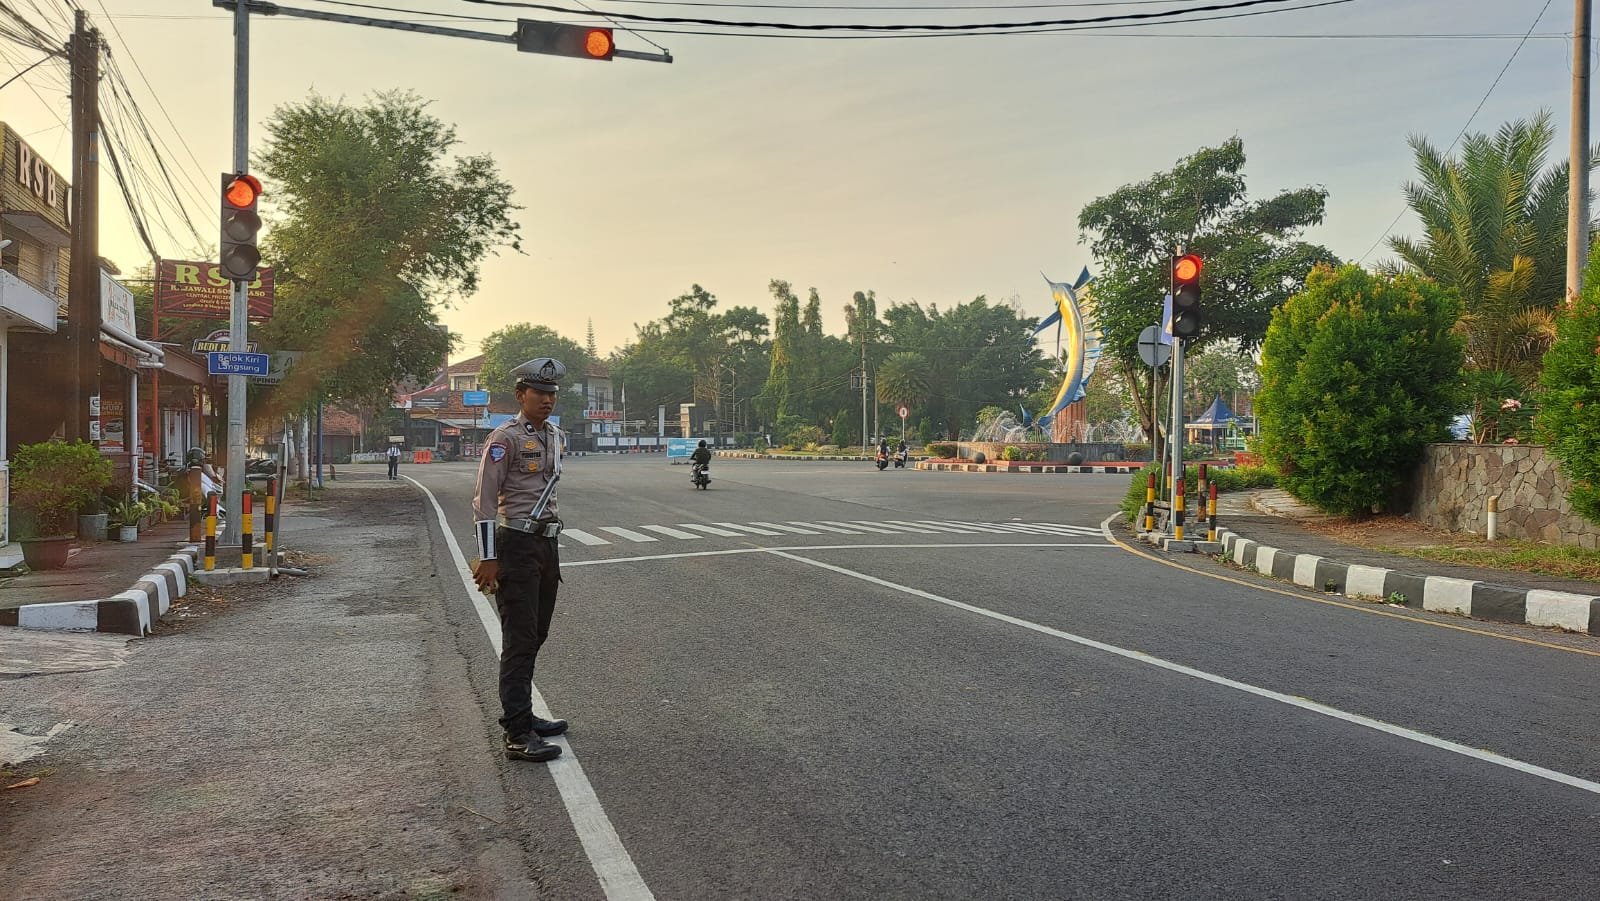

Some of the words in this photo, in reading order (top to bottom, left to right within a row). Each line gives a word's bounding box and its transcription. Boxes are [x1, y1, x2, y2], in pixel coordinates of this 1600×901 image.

[17, 140, 57, 208] RSB
[217, 353, 243, 362] Belok
[245, 354, 260, 363] Kiri
[217, 362, 260, 373] Langsung
